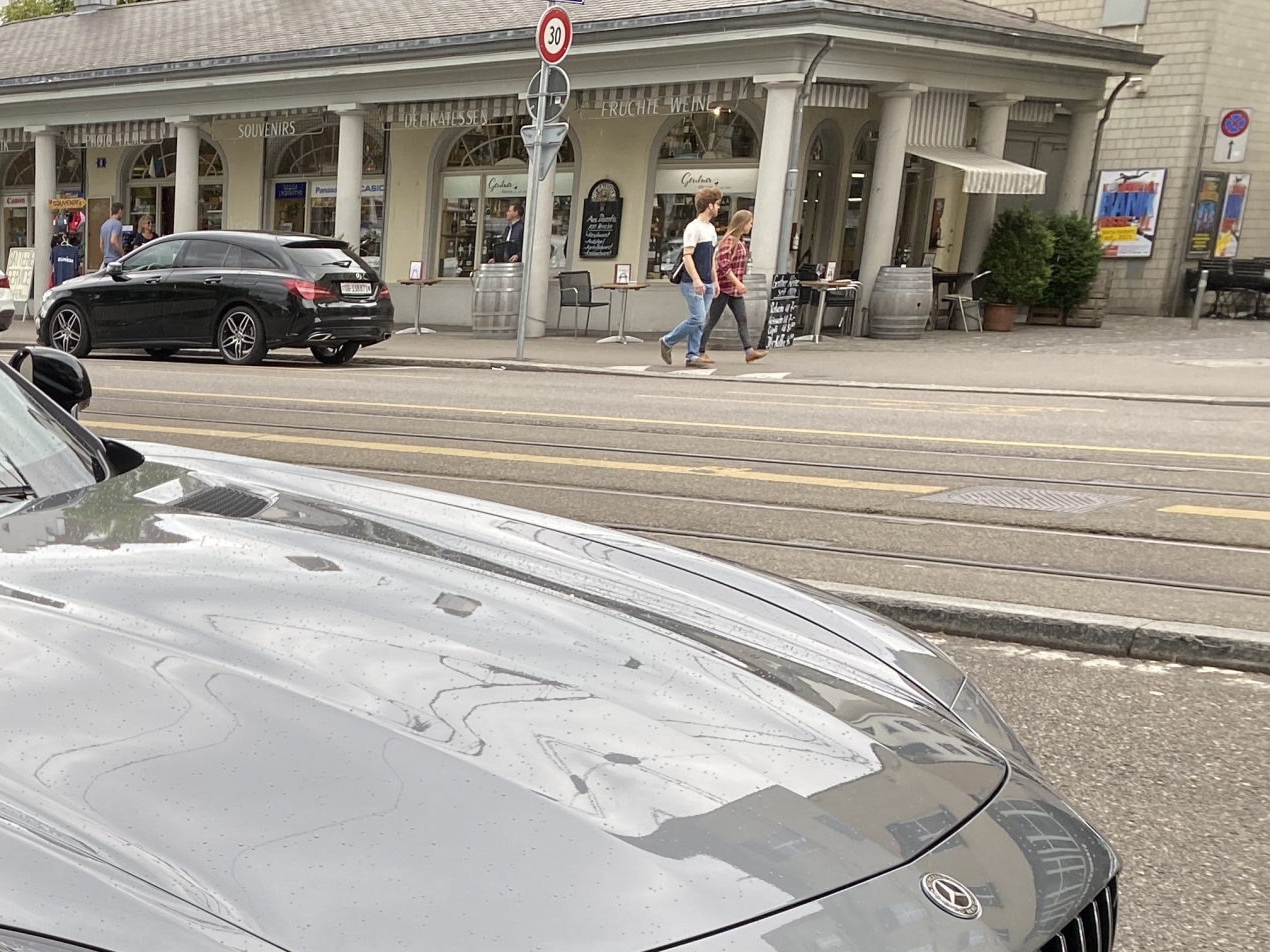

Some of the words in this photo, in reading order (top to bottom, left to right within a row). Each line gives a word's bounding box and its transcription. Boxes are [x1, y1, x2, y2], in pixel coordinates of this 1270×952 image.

[548, 26, 561, 45] 30
[404, 109, 488, 128] DELIKATESSEN
[238, 120, 296, 138] SOUVENIRS
[85, 133, 112, 147] PHOTO
[1098, 191, 1156, 218] BANK
